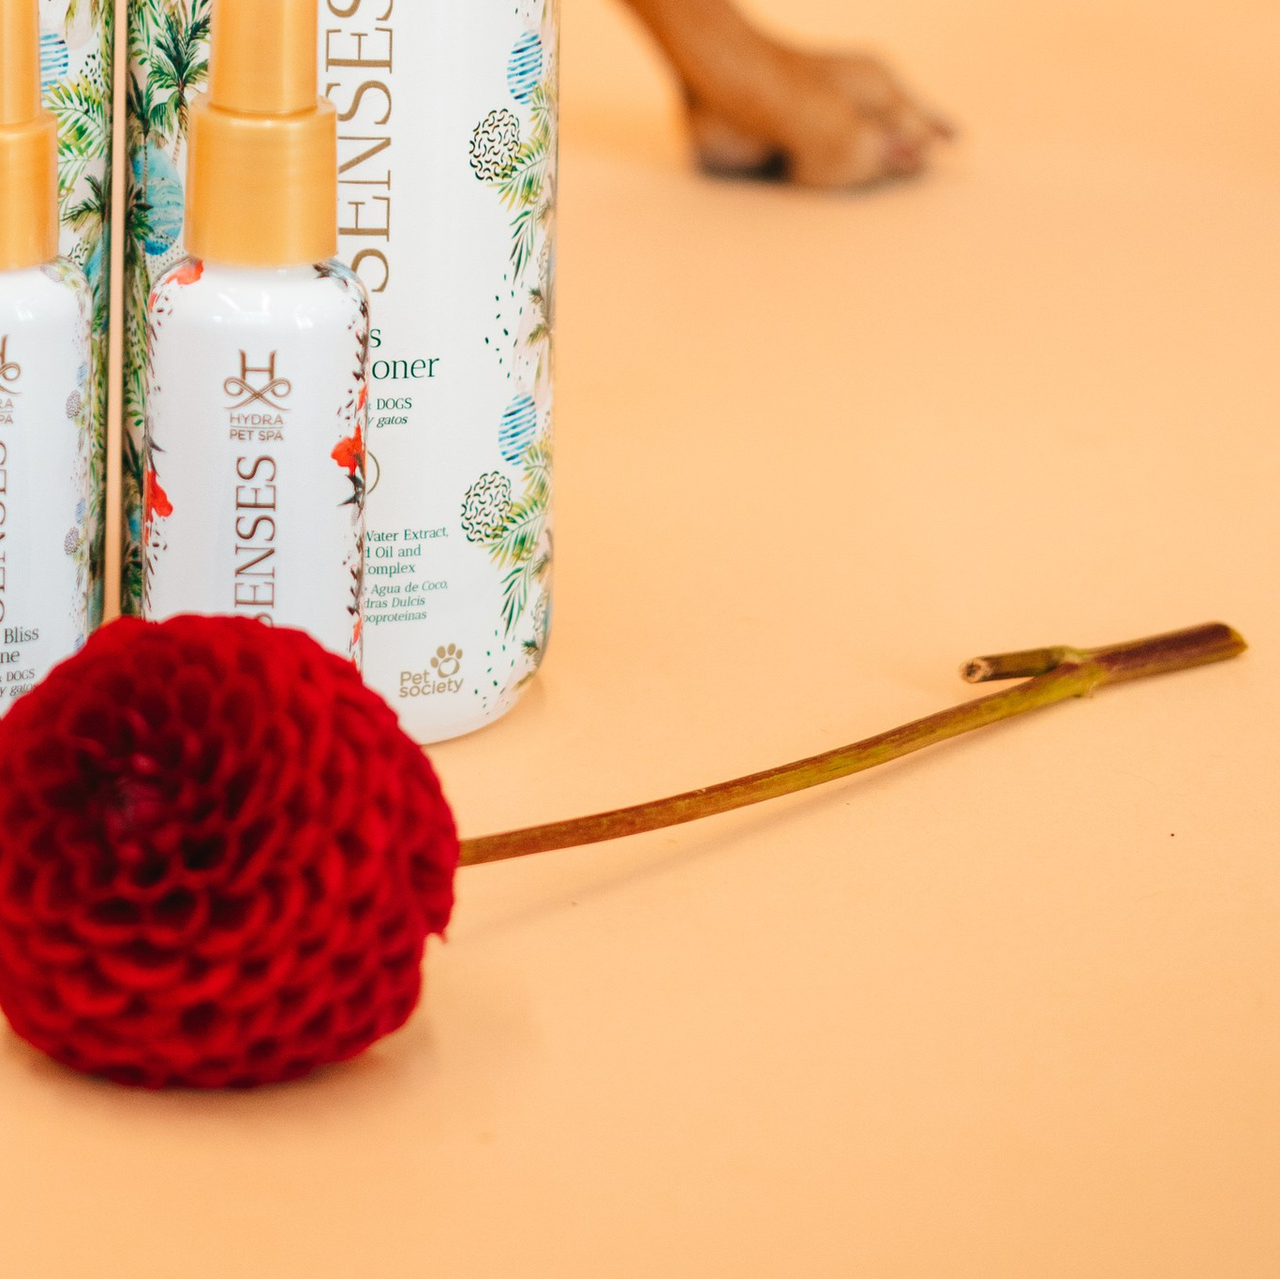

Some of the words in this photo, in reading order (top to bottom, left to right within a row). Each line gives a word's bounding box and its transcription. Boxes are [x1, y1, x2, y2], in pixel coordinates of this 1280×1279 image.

[376, 396, 413, 411] DOGS
[229, 412, 284, 426] HYDRA
[376, 415, 409, 429] gatos
[228, 428, 255, 441] PET
[258, 430, 284, 442] SPA
[403, 526, 449, 541] Extract,
[374, 545, 394, 559] Oil
[397, 543, 422, 558] and
[370, 583, 401, 597] Agua
[404, 581, 419, 593] de
[421, 580, 449, 591] Coco,
[391, 595, 426, 608] Dulcis
[3, 626, 40, 645] Bliss
[5, 668, 36, 682] DOGS
[399, 669, 430, 687] Pet
[0, 686, 7, 698] y
[398, 677, 464, 699] society
